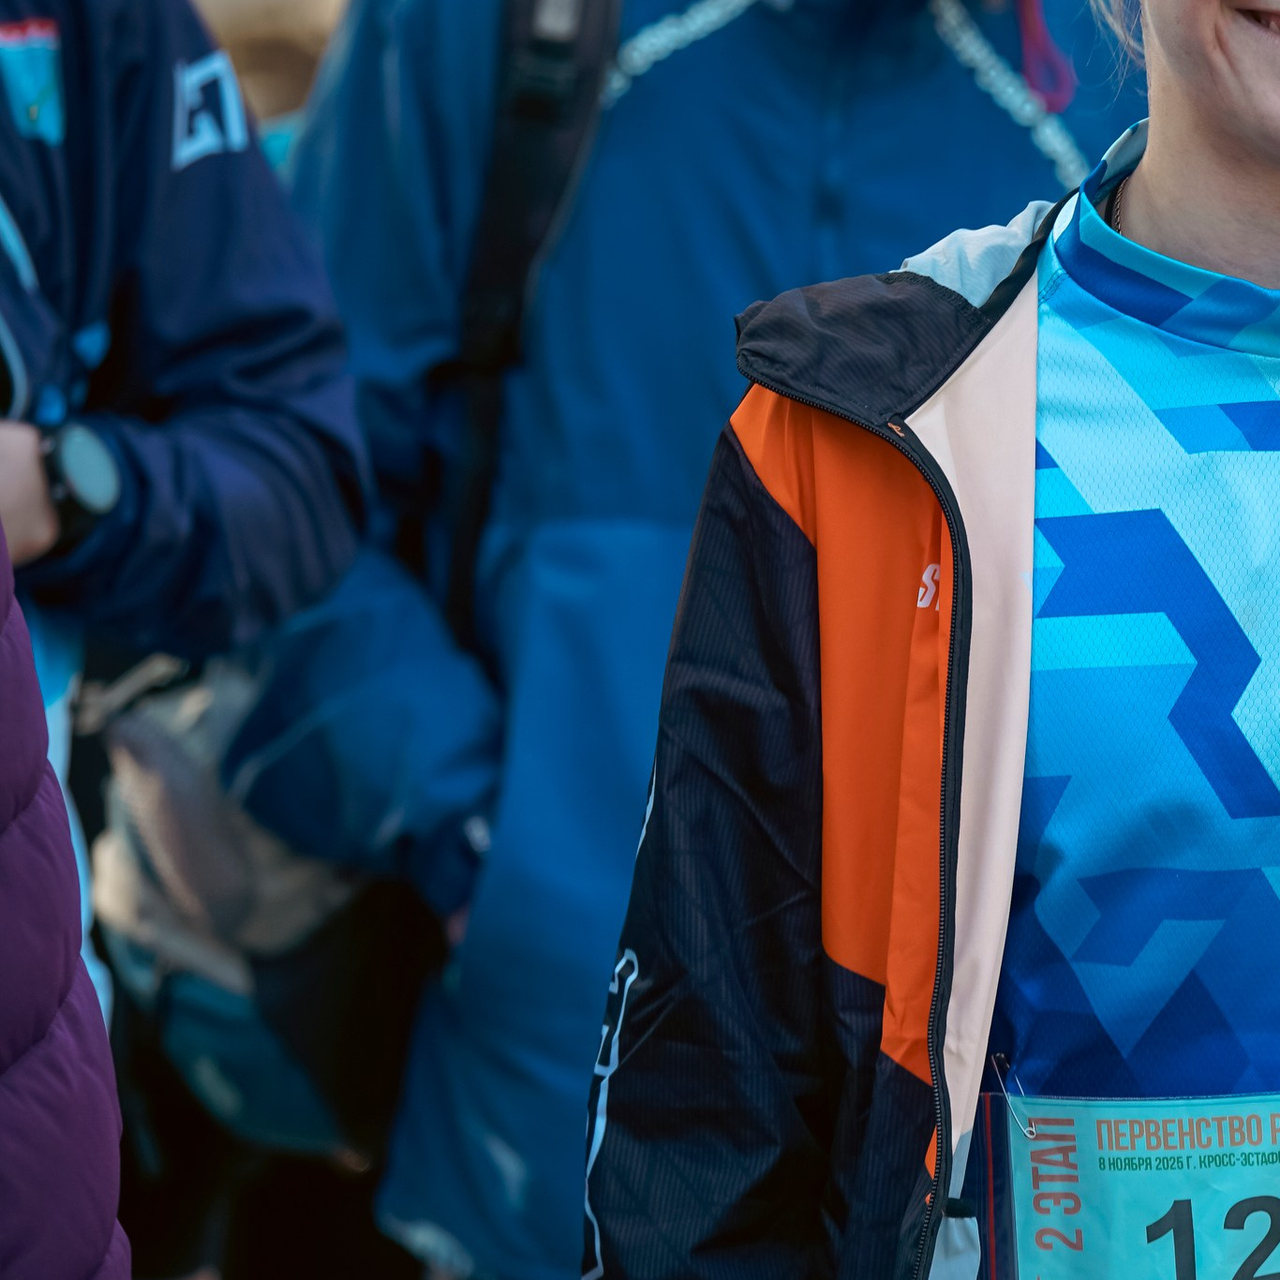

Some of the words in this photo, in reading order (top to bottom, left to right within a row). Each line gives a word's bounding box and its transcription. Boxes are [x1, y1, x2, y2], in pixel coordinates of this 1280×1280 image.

[1096, 1114, 1262, 1151] ПЕРВЕНСТВО
[1028, 1117, 1082, 1215] ЭТАП
[1098, 1156, 1106, 1171] 8
[1108, 1157, 1151, 1171] НОЯБРЯ
[1155, 1156, 1184, 1171] 2025
[1034, 1227, 1083, 1252] 2
